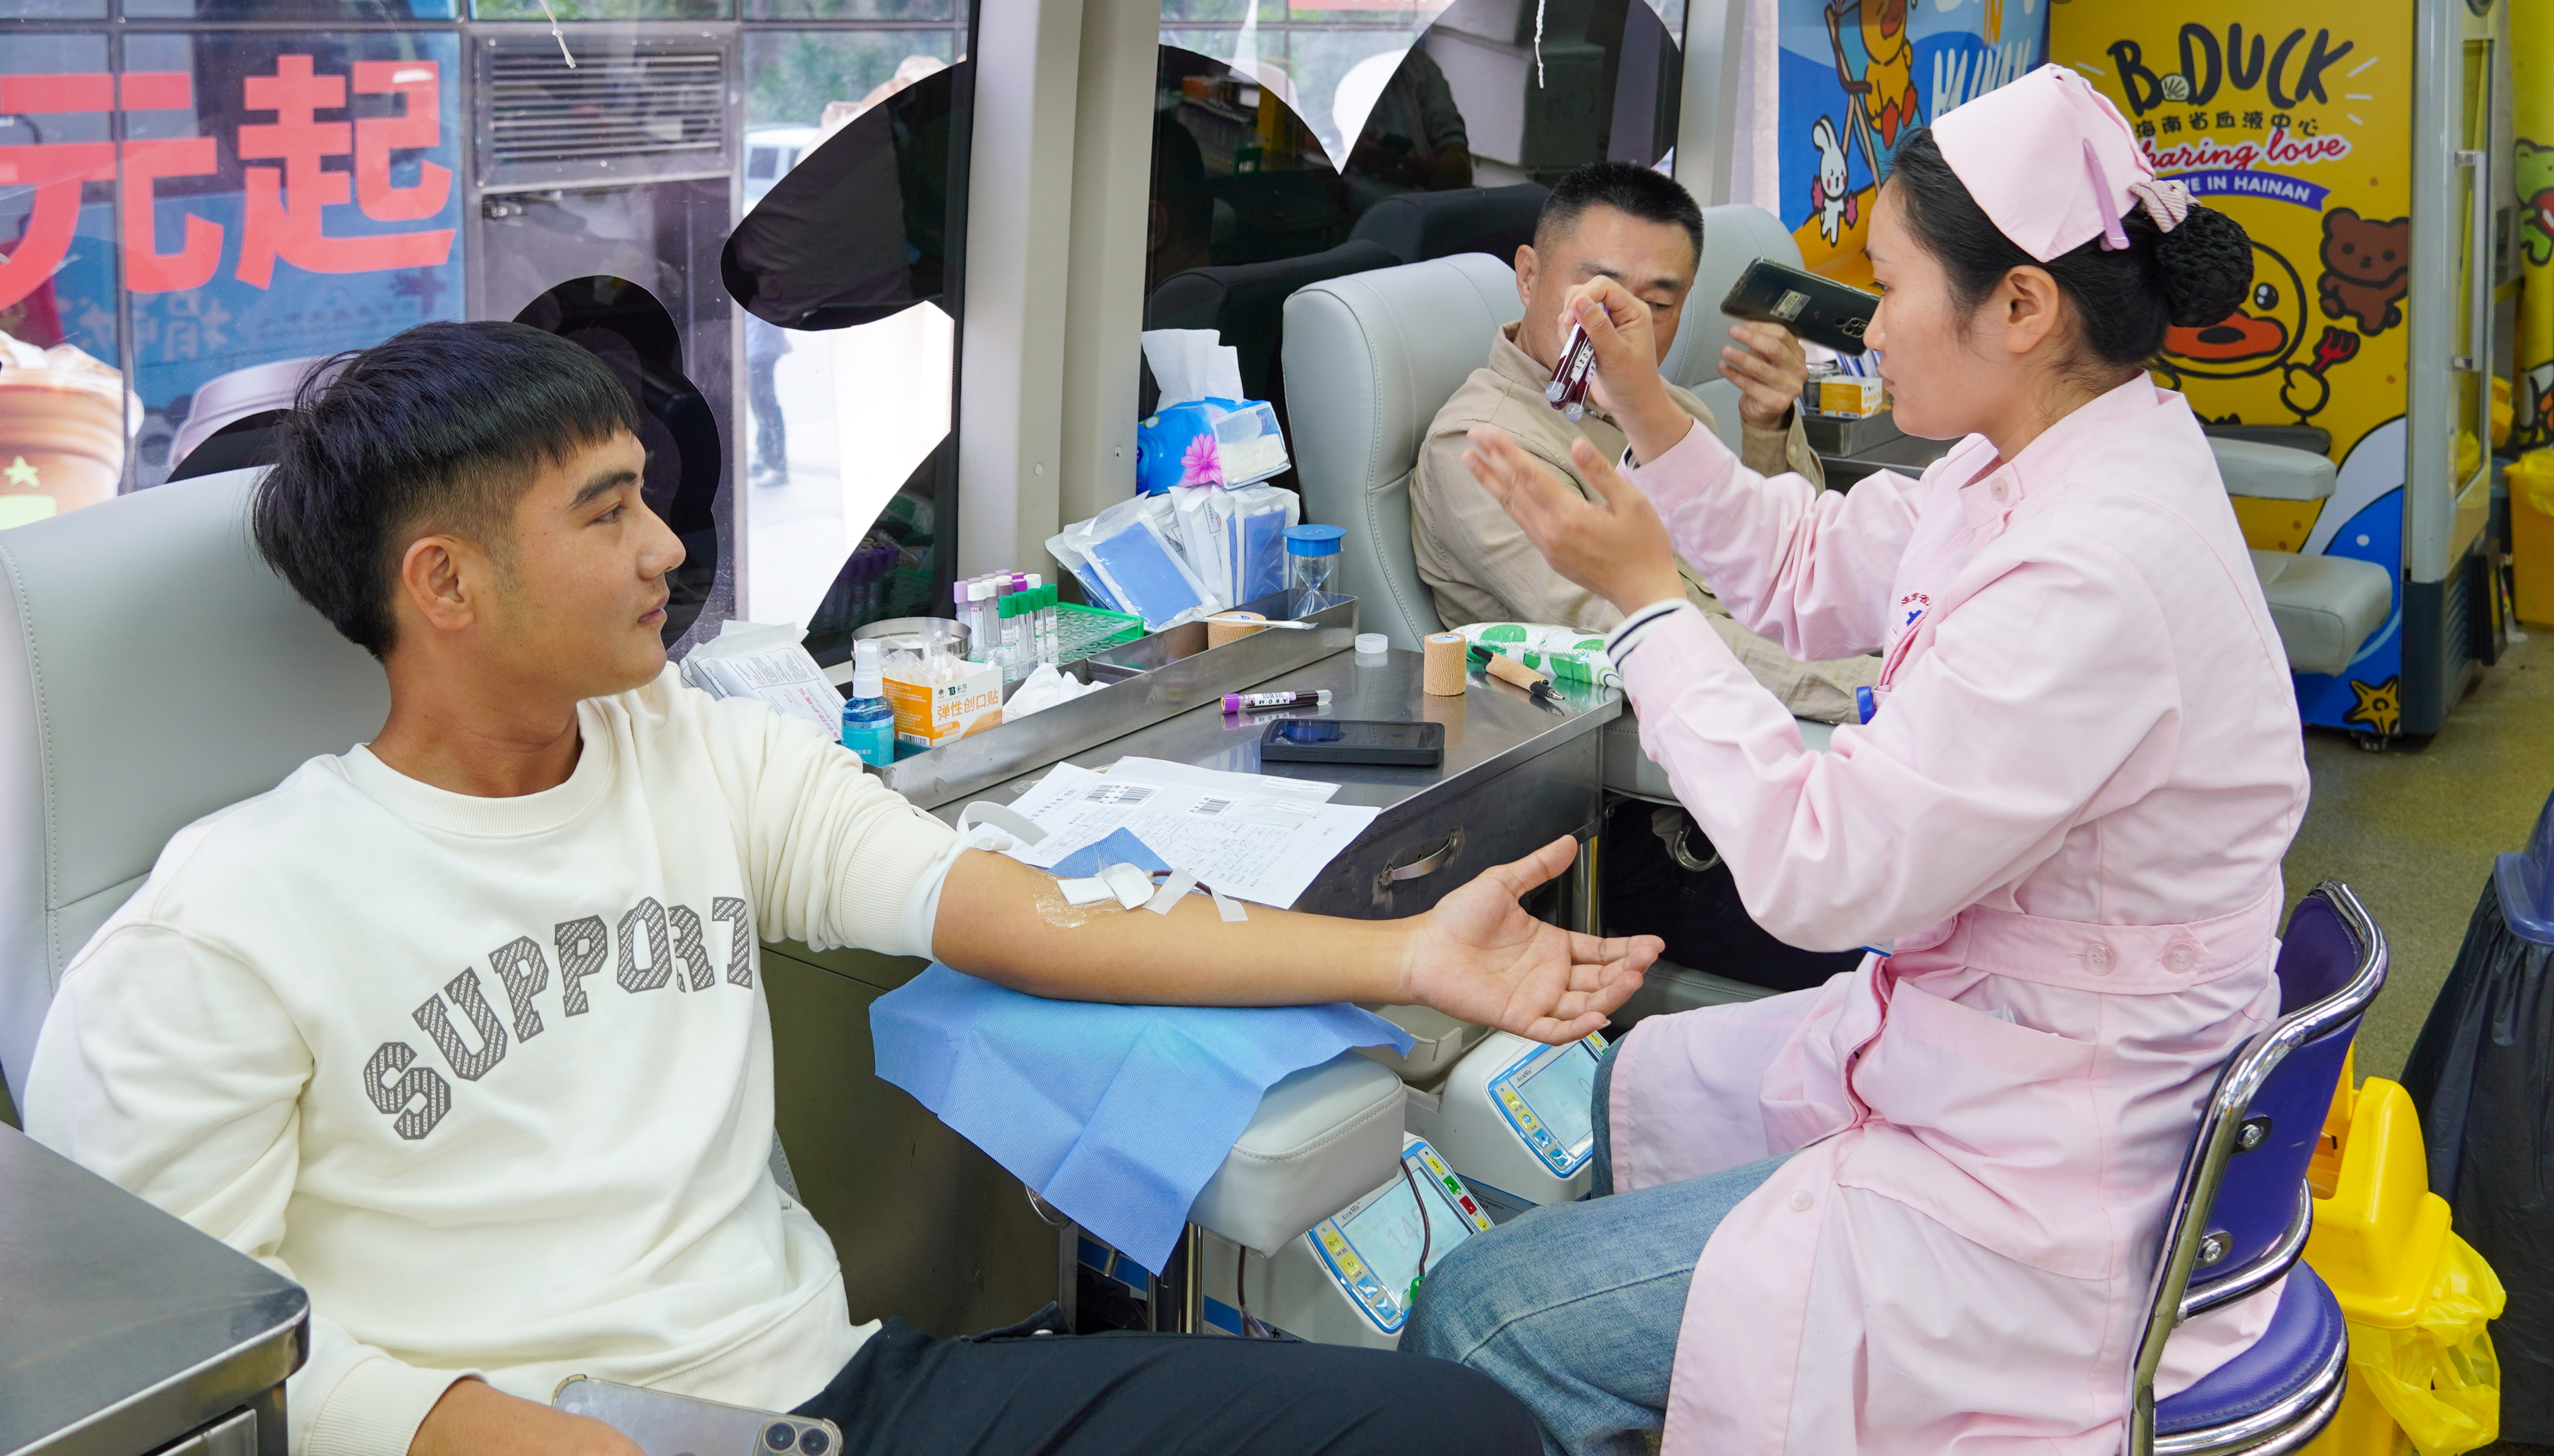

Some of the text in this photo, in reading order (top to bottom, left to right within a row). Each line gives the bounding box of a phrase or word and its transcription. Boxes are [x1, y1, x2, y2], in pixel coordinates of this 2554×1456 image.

[2135, 110, 2319, 138] 海南省血液中心
[2141, 129, 2346, 171] haring love
[0, 54, 456, 309] 元起
[2207, 176, 2227, 190] IN
[2234, 177, 2310, 203] HAINAN
[937, 689, 999, 721] 弹性创口贴
[363, 896, 753, 1140] SUPPORT
